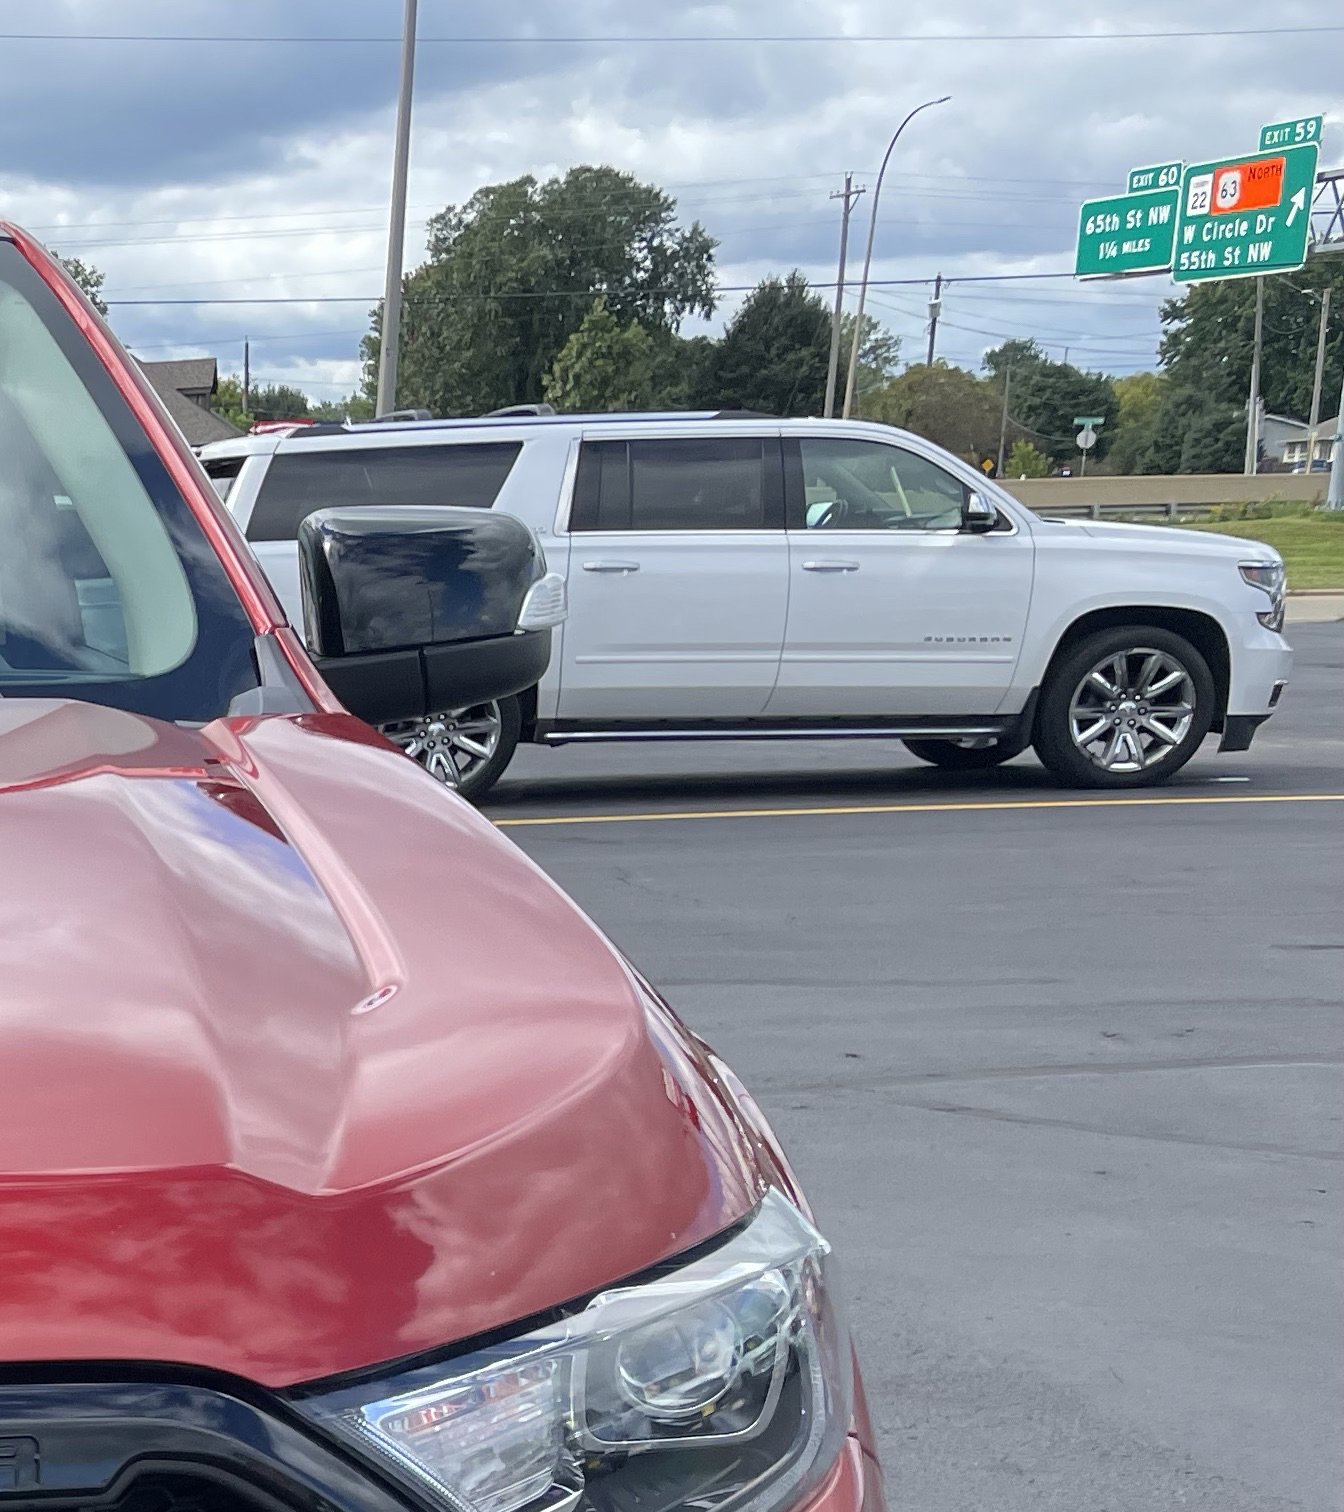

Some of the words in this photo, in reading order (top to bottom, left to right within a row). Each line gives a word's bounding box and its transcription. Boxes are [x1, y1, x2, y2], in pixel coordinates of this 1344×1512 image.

[1265, 127, 1290, 144] EXIT
[1295, 120, 1316, 142] 59
[1133, 173, 1154, 188] EXIT
[1158, 166, 1178, 186] 60
[1248, 164, 1283, 182] NORTH
[1191, 191, 1207, 210] 22
[1220, 180, 1237, 199] 63
[1085, 213, 1120, 235] 65th
[1126, 209, 1143, 229] St
[1147, 204, 1171, 226] NW
[1183, 224, 1196, 244] W
[1202, 218, 1249, 242] Circle
[1255, 214, 1275, 235] Dr
[1121, 238, 1151, 254] MILES
[1179, 250, 1216, 270] 55th
[1223, 246, 1241, 266] St
[1246, 240, 1272, 263] NW
